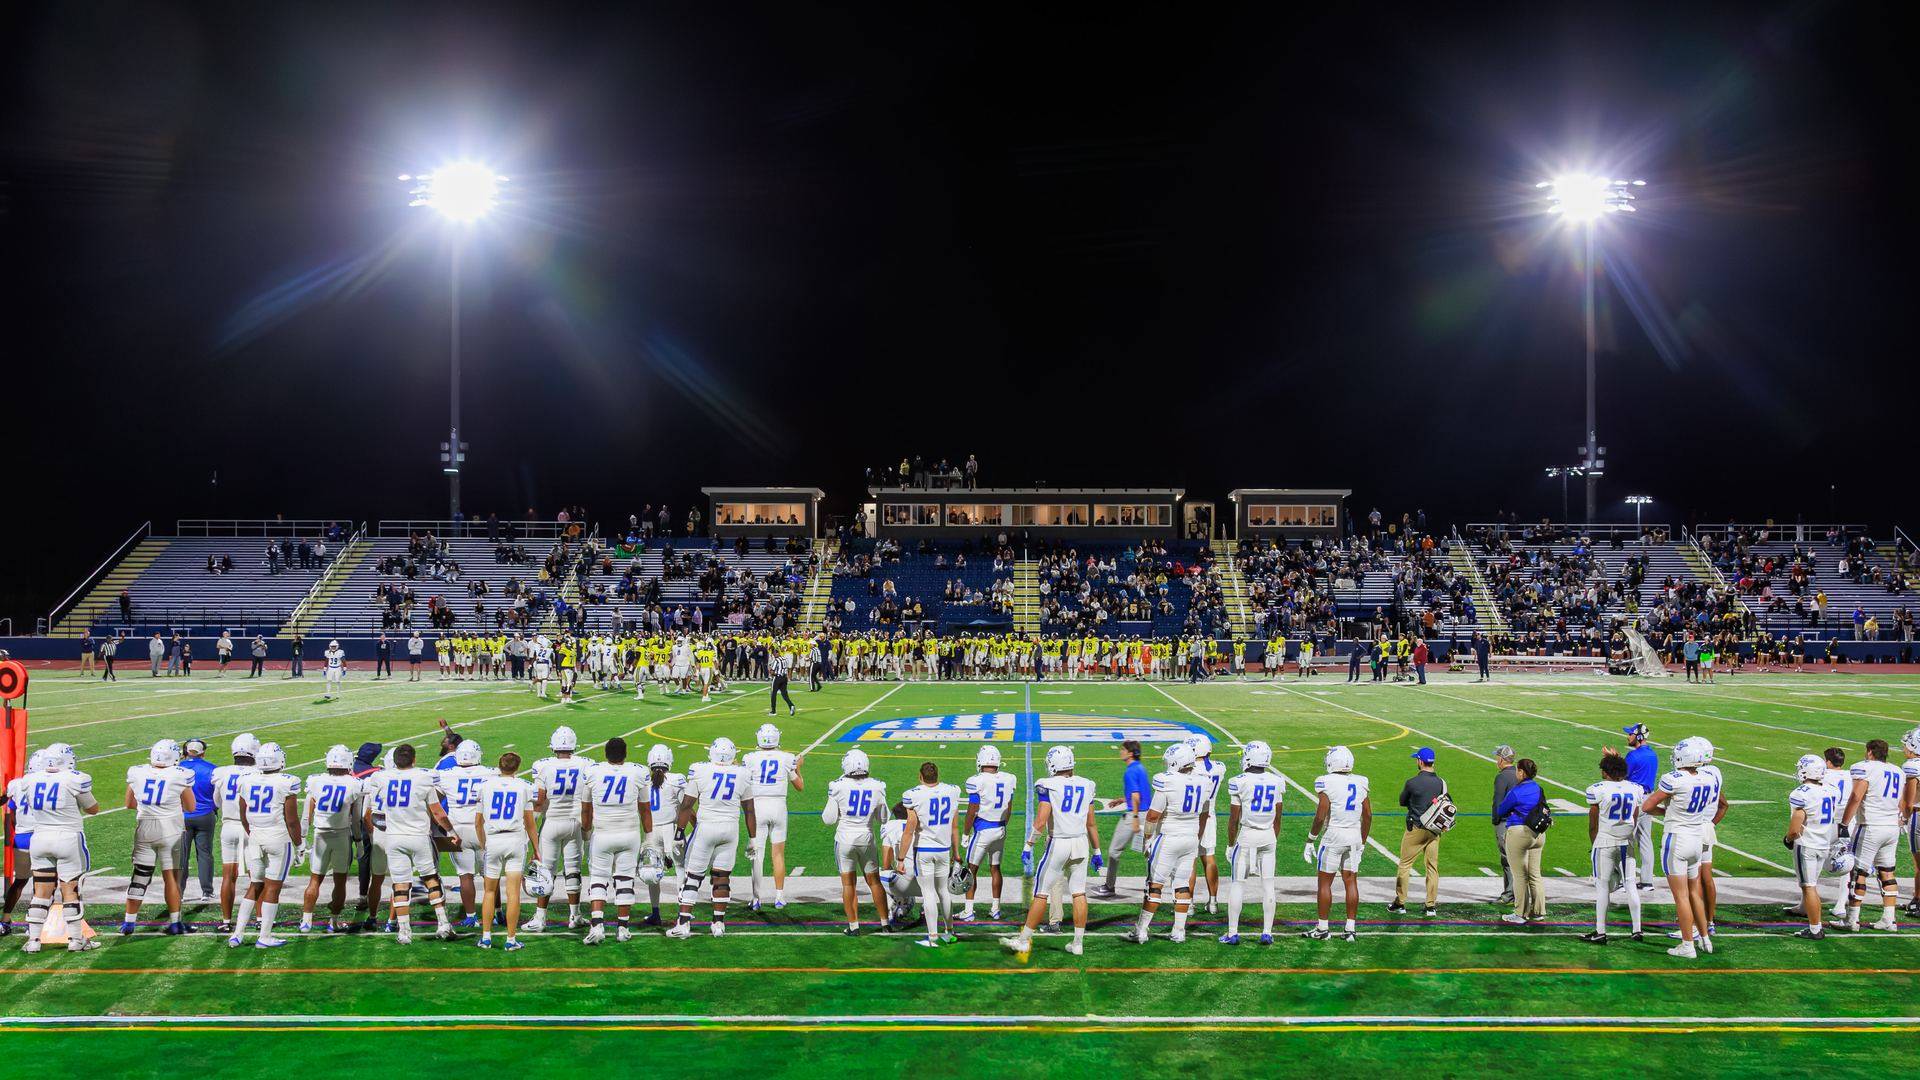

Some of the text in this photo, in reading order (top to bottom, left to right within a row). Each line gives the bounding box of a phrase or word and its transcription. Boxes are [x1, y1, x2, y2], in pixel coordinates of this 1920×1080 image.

[330, 657, 338, 665] 39
[538, 649, 547, 658] 22
[656, 653, 666, 663] 79
[552, 768, 580, 796] 53
[760, 759, 779, 784] 12
[1882, 770, 1900, 799] 79
[33, 782, 60, 811] 64
[142, 778, 166, 806] 51
[248, 785, 274, 813] 52
[317, 784, 347, 813] 20
[386, 779, 412, 807] 69
[456, 778, 482, 805] 55
[601, 775, 628, 804] 74
[710, 772, 737, 801] 75
[994, 782, 1005, 809] 5
[1060, 785, 1085, 814] 87
[1182, 785, 1202, 813] 61
[1250, 784, 1276, 812] 85
[1345, 783, 1357, 811] 2
[1686, 785, 1711, 813] 88
[489, 791, 518, 820] 98
[846, 789, 873, 817] 96
[928, 796, 951, 826] 92
[1608, 793, 1635, 820] 26
